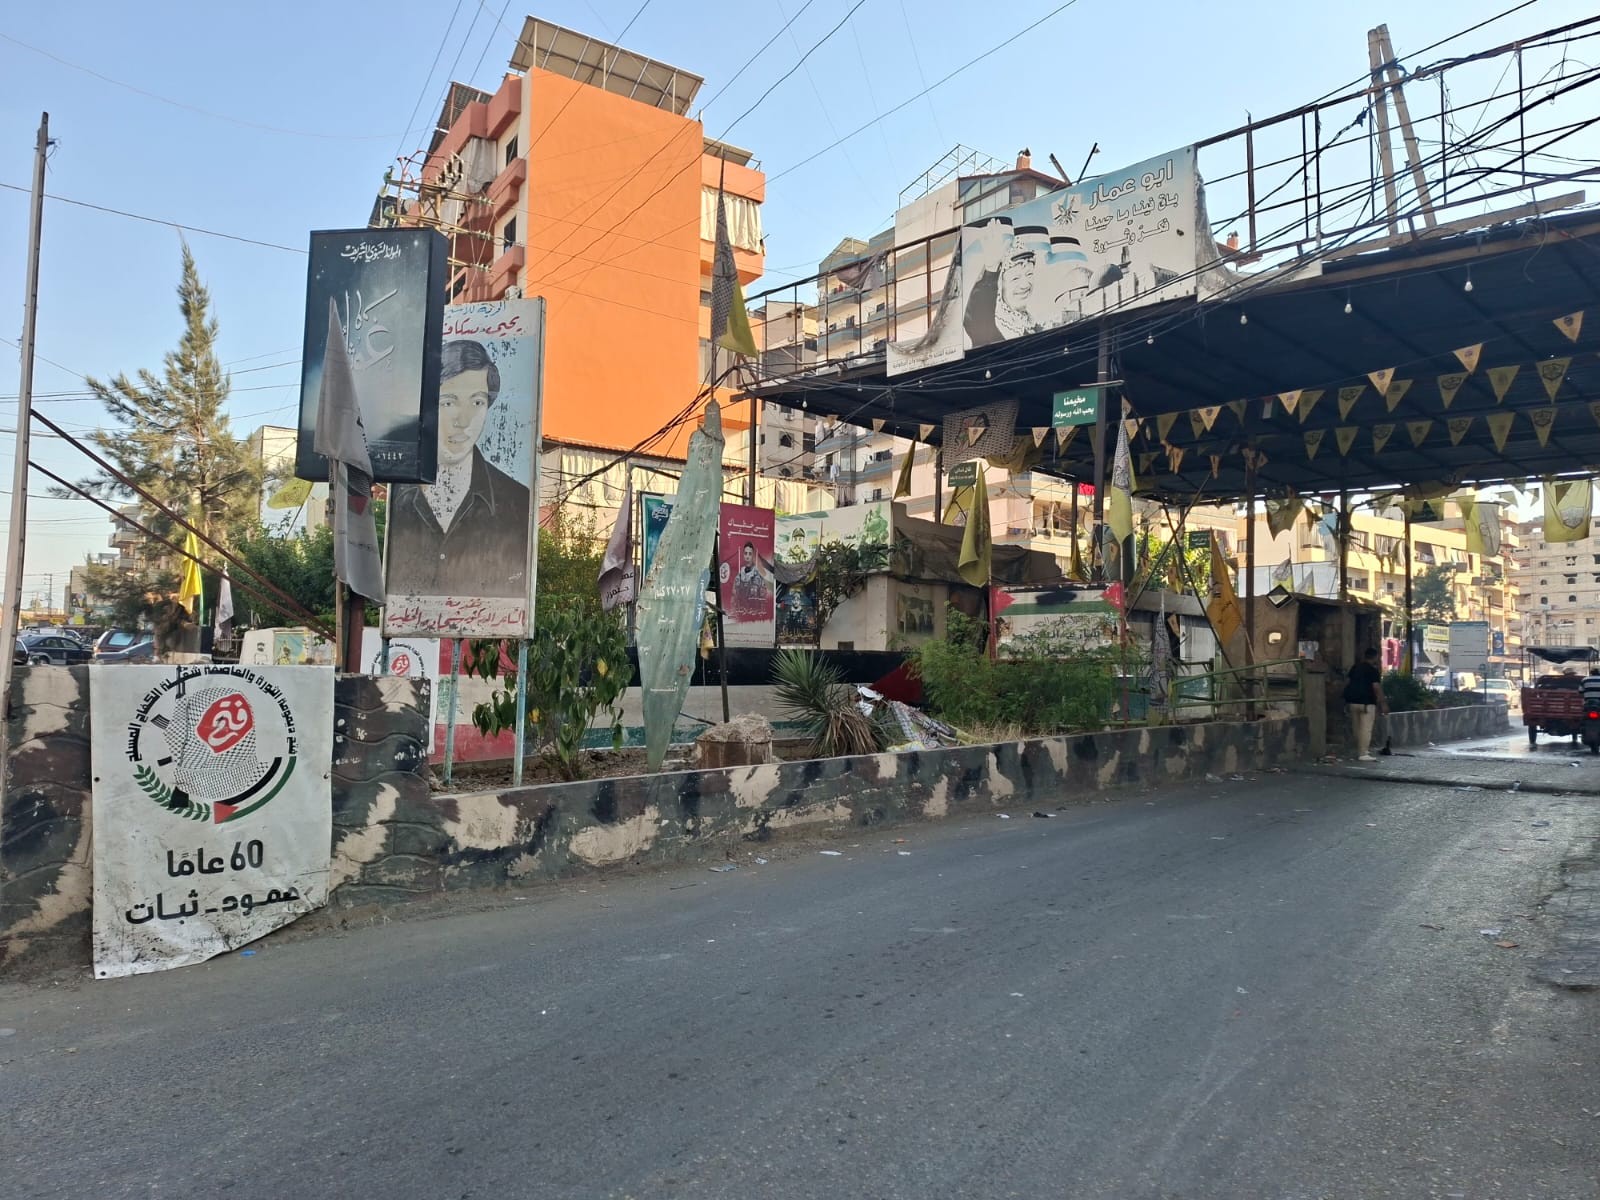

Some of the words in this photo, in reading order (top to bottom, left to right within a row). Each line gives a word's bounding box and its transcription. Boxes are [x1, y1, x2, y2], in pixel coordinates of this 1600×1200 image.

[1140, 158, 1174, 191] ابو
[1088, 177, 1136, 210] عمار
[1054, 410, 1072, 419] ورسوله
[1063, 395, 1086, 407] مخيمنا
[1072, 406, 1082, 415] الله
[1081, 407, 1095, 416] يحب
[255, 676, 283, 700] الثورة
[136, 687, 163, 723] الكفاح
[207, 699, 248, 747] فتح
[125, 722, 143, 762] المسلح
[230, 838, 264, 872] 60
[125, 889, 200, 926] ثبات
